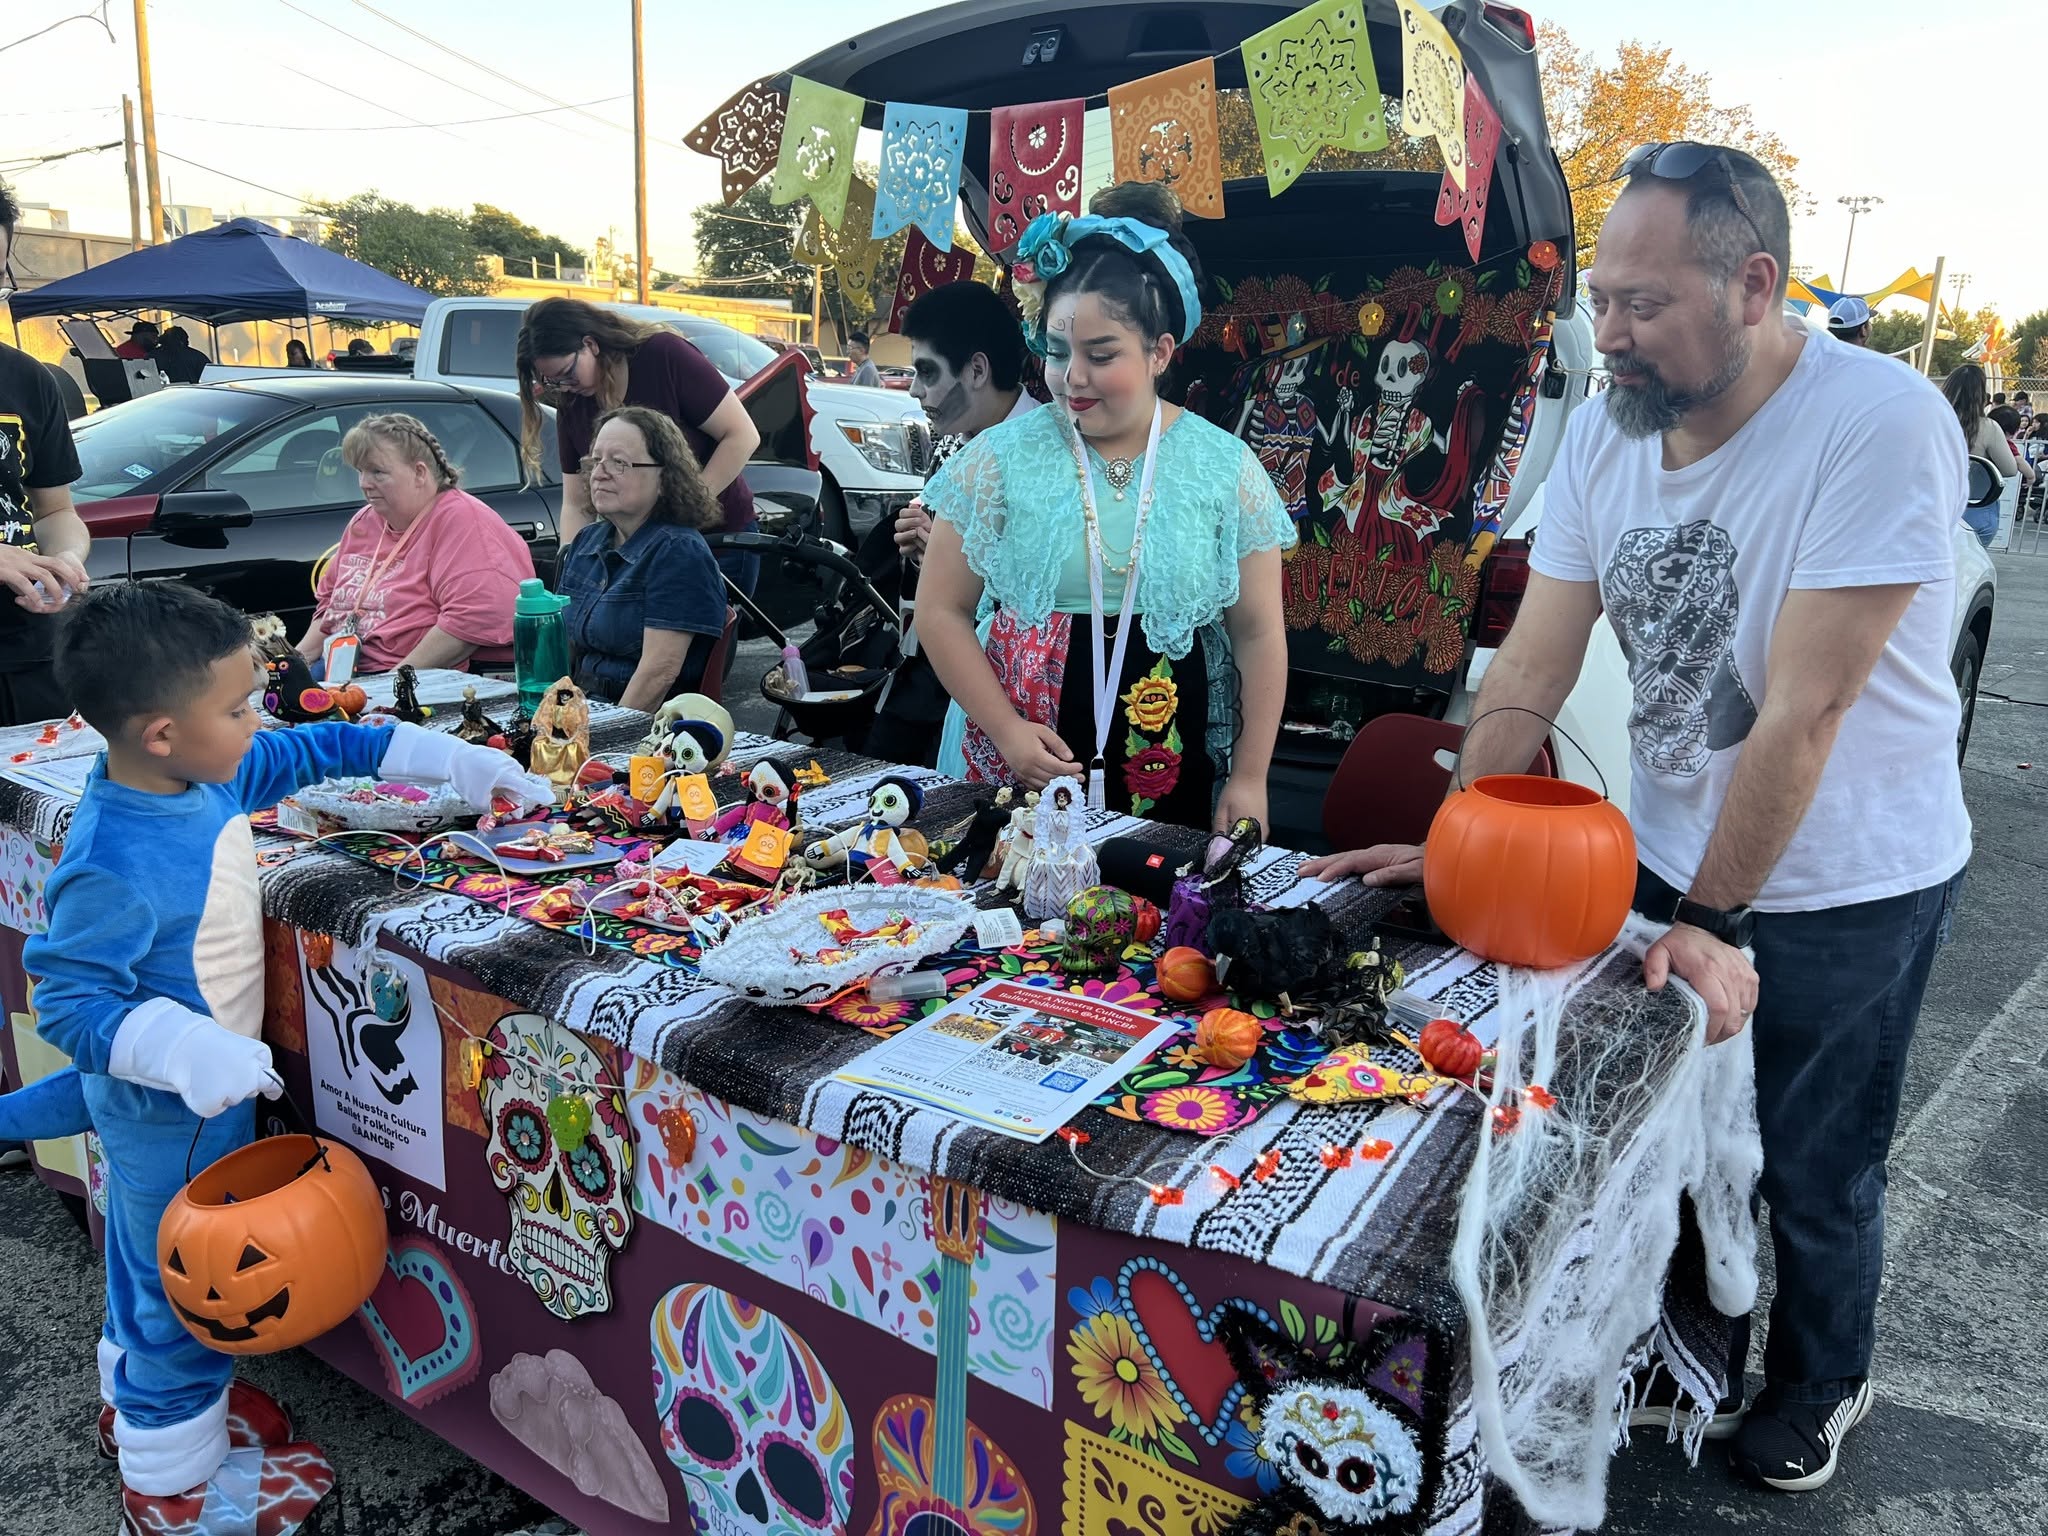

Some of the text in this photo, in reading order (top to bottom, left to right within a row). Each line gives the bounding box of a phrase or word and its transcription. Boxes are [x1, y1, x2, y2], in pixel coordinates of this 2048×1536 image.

[1335, 361, 1361, 389] de
[997, 991, 1138, 1031] Ballet Folklorico @AANCBF
[1013, 988, 1134, 1023] Amor A Nuestra Cultura
[880, 1065, 931, 1084] CHARLEY
[931, 1080, 974, 1097] TAYLOR
[320, 1079, 427, 1138] Amor A Nuestra Cultura
[336, 1100, 410, 1145] Ballet Folklorico
[351, 1122, 396, 1152] @AANCBF
